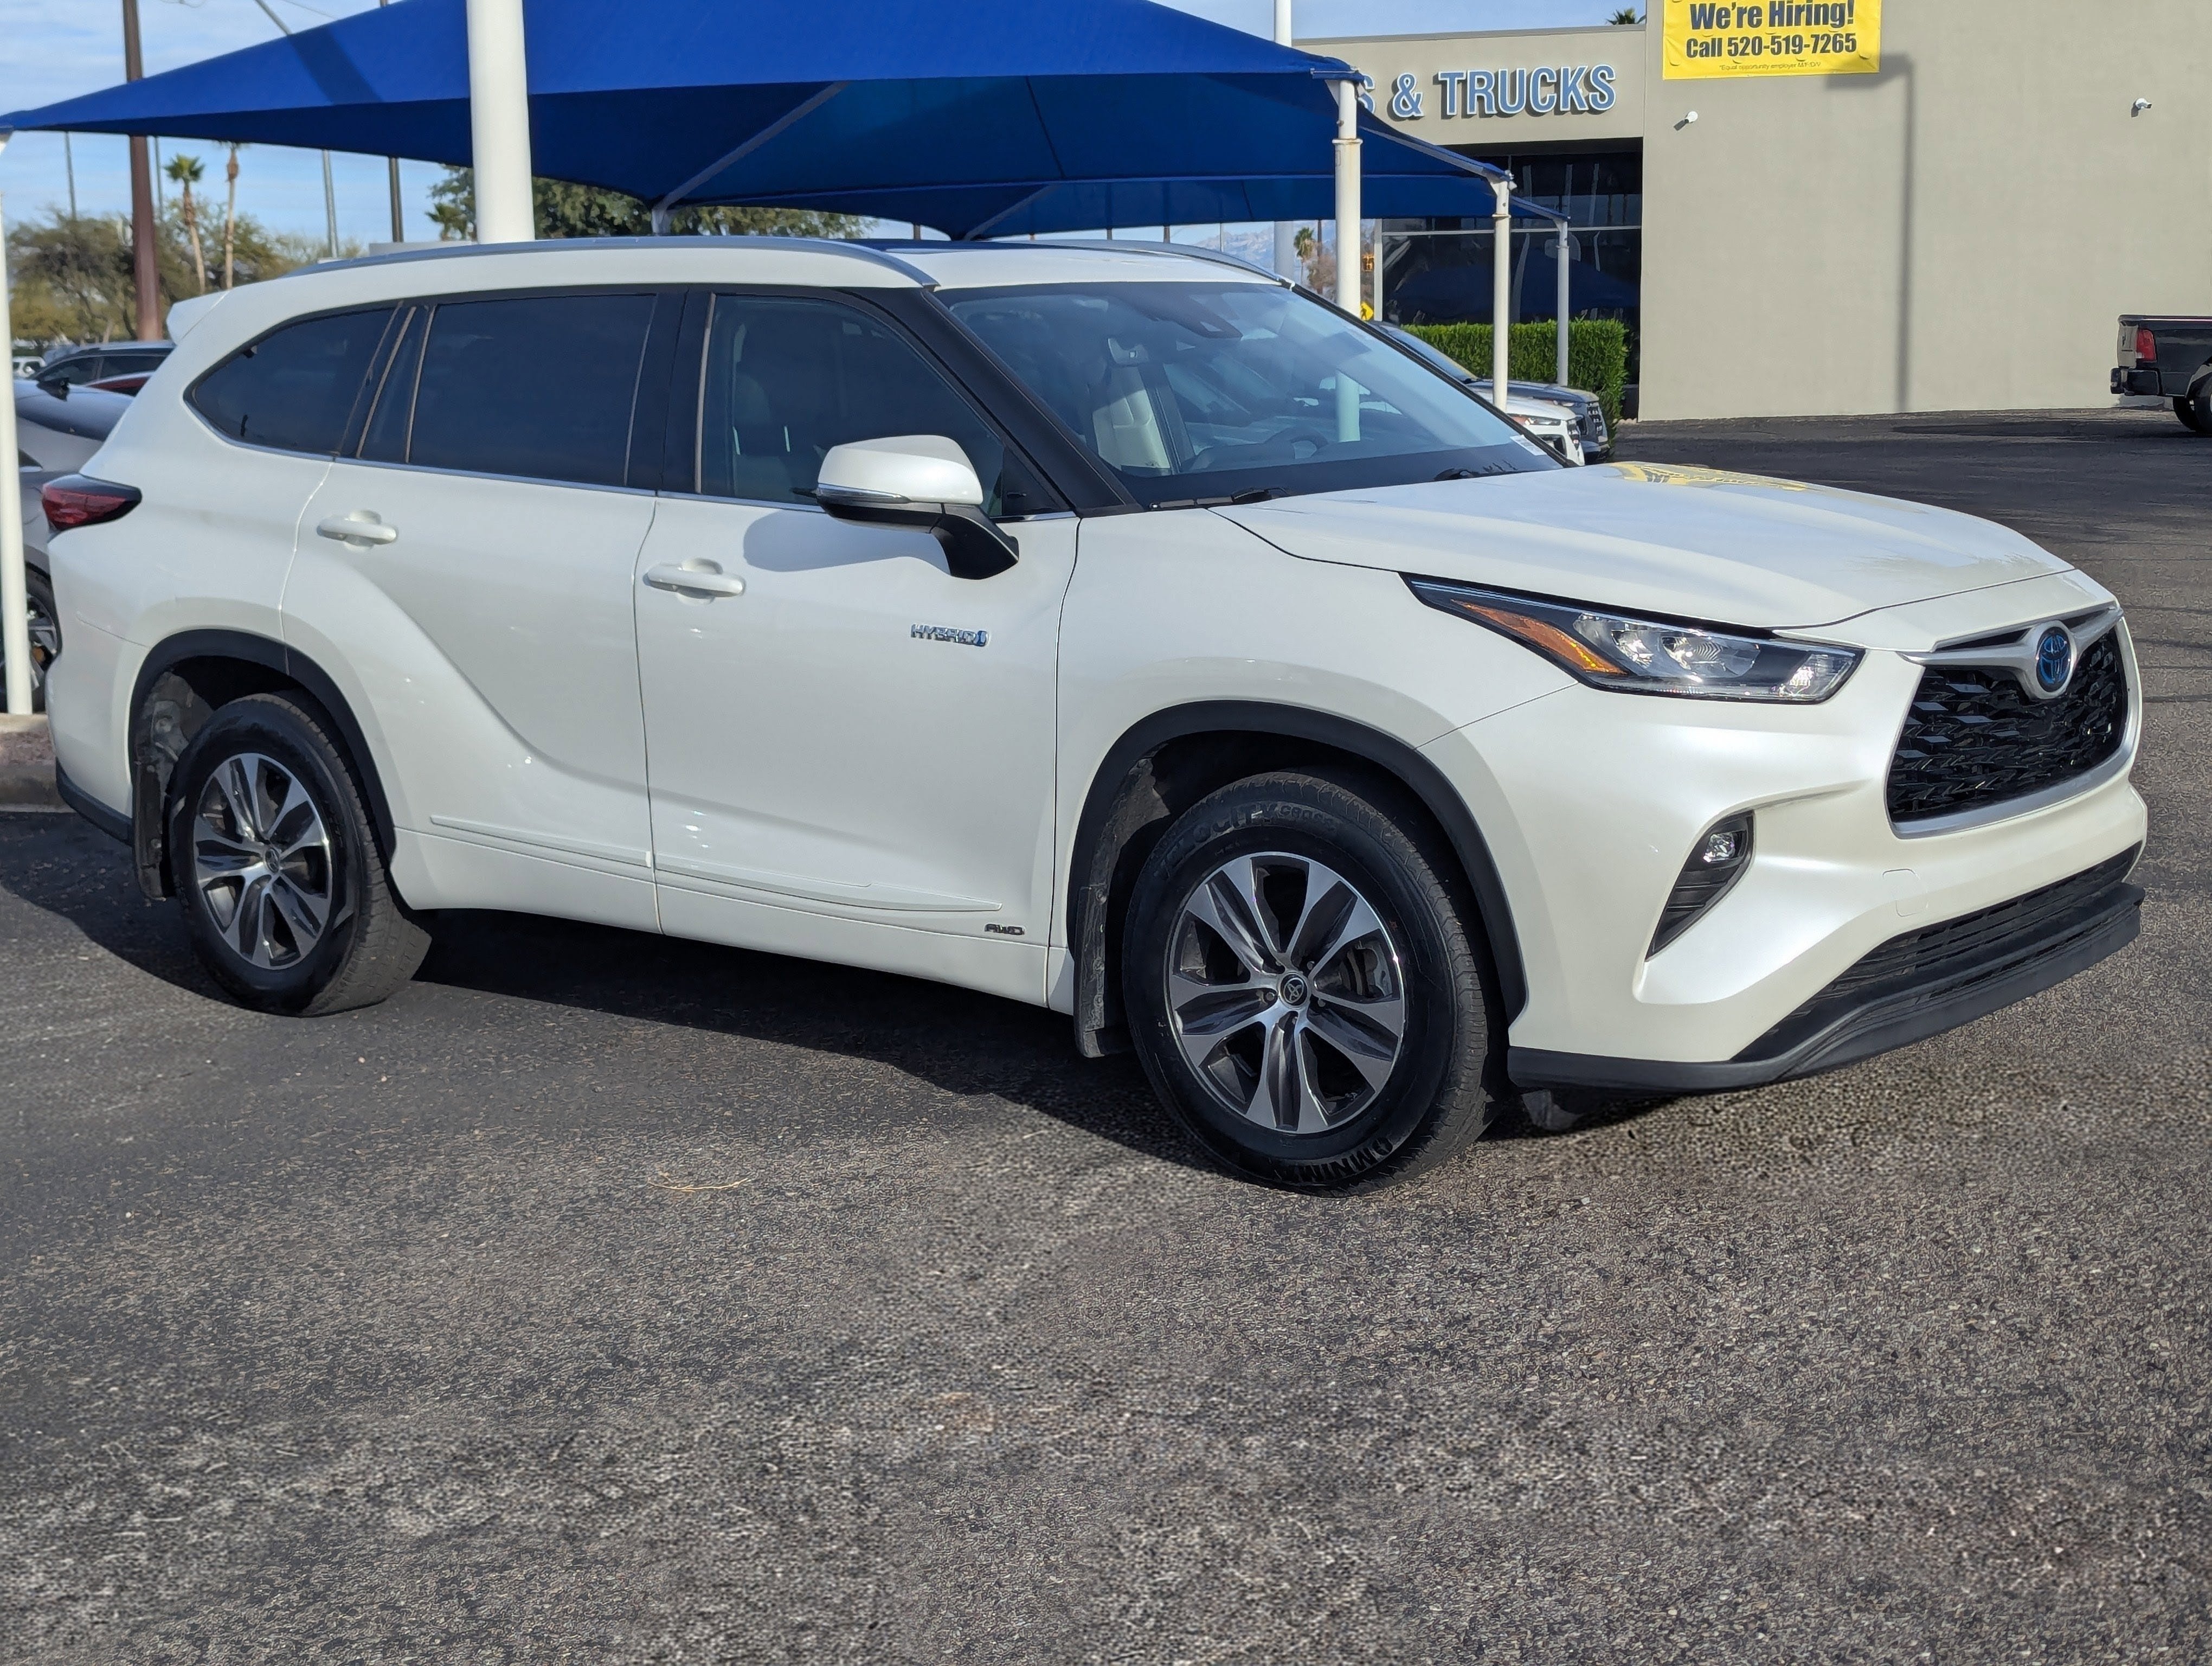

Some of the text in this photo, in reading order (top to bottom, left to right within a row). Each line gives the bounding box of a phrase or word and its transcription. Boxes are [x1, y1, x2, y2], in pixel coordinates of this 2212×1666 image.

[1690, 0, 1854, 30] We're Hiring!
[1686, 33, 1856, 58] Call 520-519-7265
[1392, 72, 1425, 118] &
[1438, 63, 1616, 116] TRUCKS
[911, 623, 977, 645] HYBRID
[984, 923, 1025, 935] AWD
